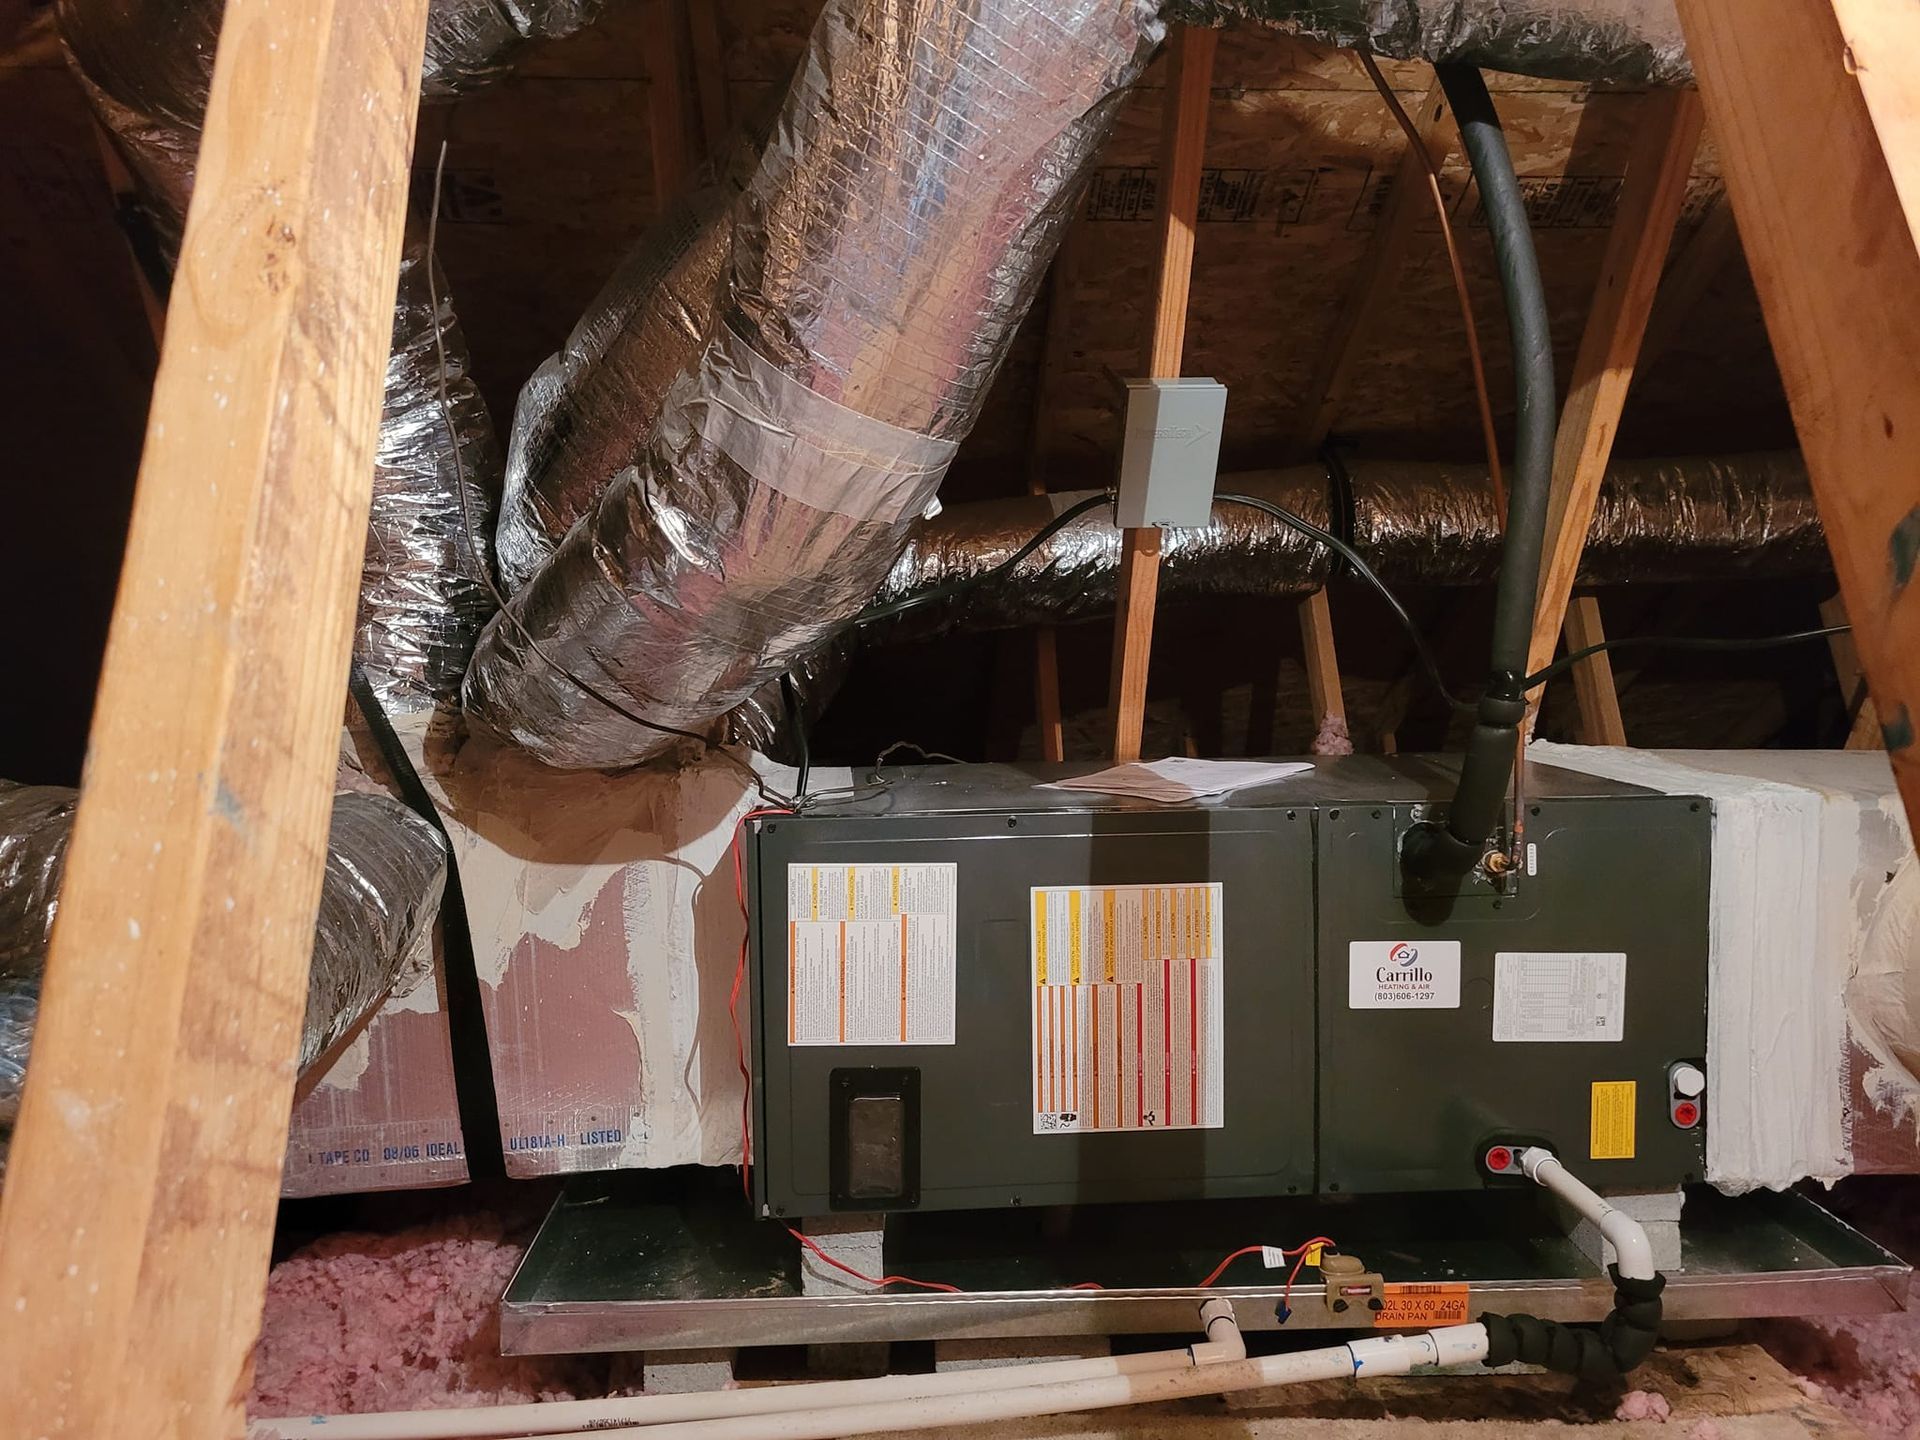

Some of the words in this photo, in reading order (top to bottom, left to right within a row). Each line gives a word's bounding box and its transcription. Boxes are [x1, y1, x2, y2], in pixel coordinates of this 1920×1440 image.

[1376, 966, 1432, 982] Carrillo
[1374, 992, 1435, 1001] (803)606-1297
[510, 1134, 565, 1150] UL181A-H
[580, 1130, 622, 1145] LISTED
[318, 1150, 349, 1164] TAPE
[384, 1145, 419, 1160] 08/06
[426, 1142, 461, 1156] IDEAL
[1401, 1300, 1412, 1310] 30
[1415, 1300, 1422, 1310] X
[1440, 1299, 1466, 1310] 24GA
[1375, 1312, 1405, 1320] DRAIN
